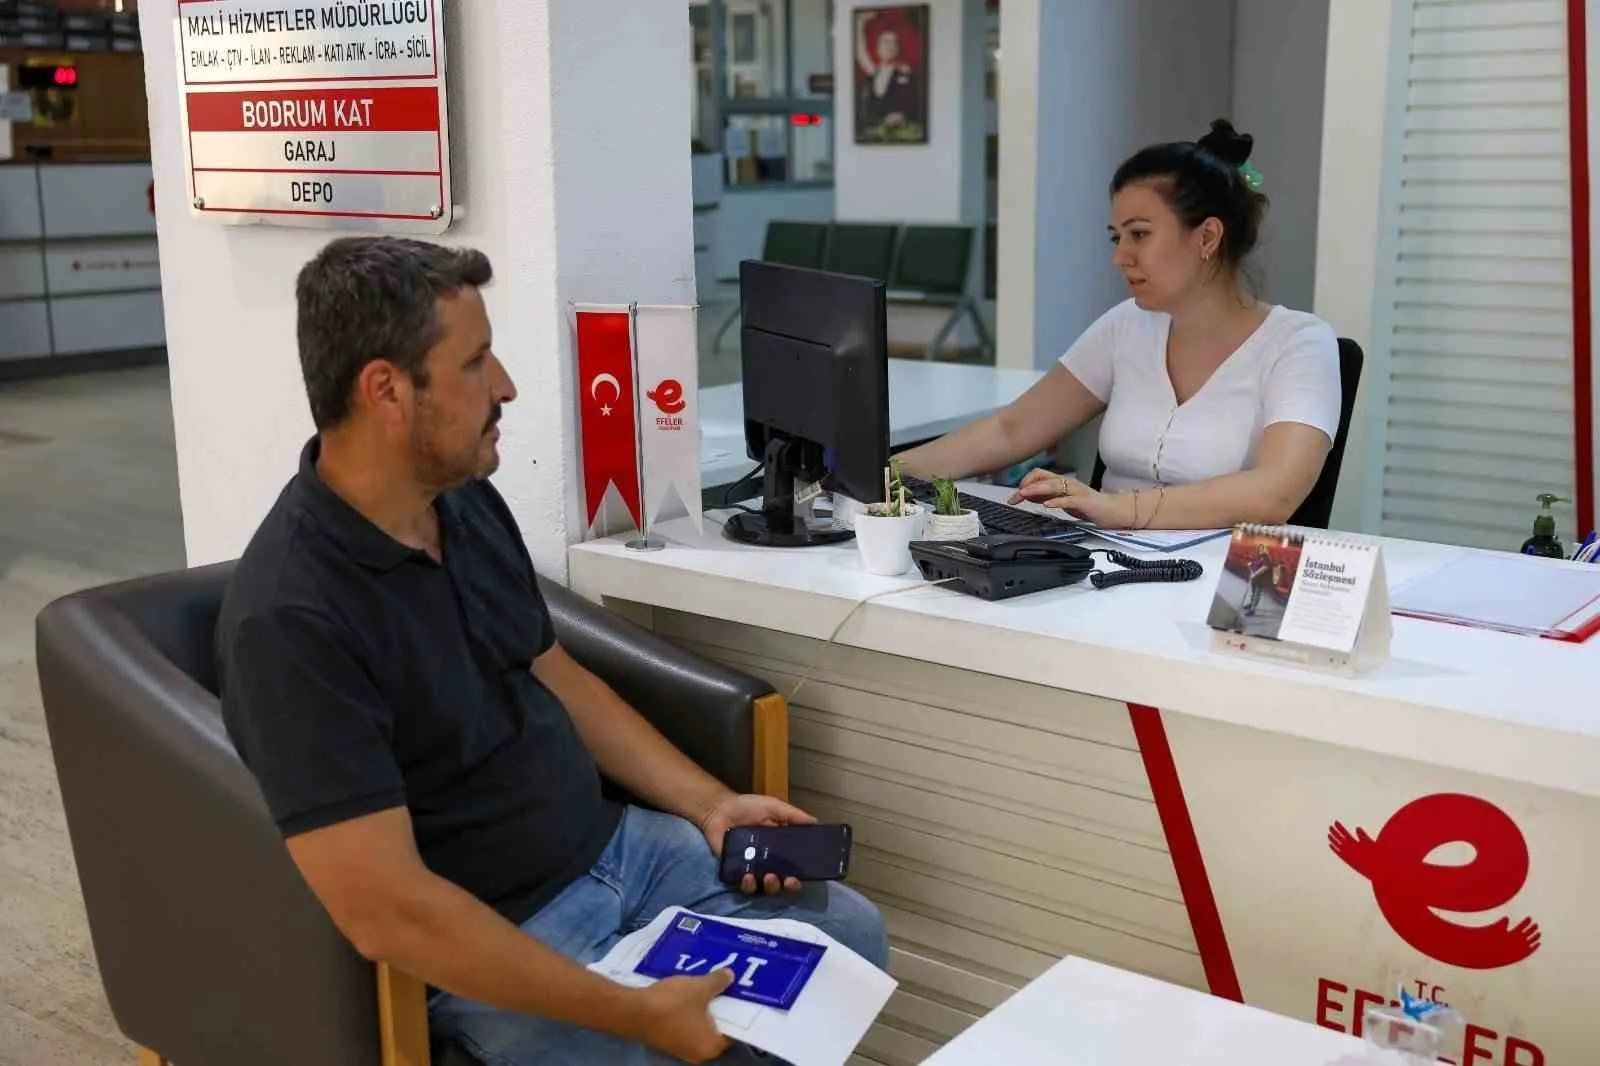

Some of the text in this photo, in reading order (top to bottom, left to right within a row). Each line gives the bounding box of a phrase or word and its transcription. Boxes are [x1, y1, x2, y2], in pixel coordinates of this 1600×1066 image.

[188, 10, 225, 37] MALİ
[228, 8, 316, 36] HİZMETLER
[190, 50, 219, 68] EMLAK
[250, 44, 271, 66] İLAN
[279, 45, 315, 64] REKLAM
[324, 42, 344, 61] KATI
[346, 42, 366, 60] ATIK
[374, 38, 397, 59] İCRA
[407, 35, 431, 59] SİCİL
[242, 99, 374, 128] BODRUM KAT
[284, 141, 336, 162] GARAJ
[291, 182, 333, 203] DEPO
